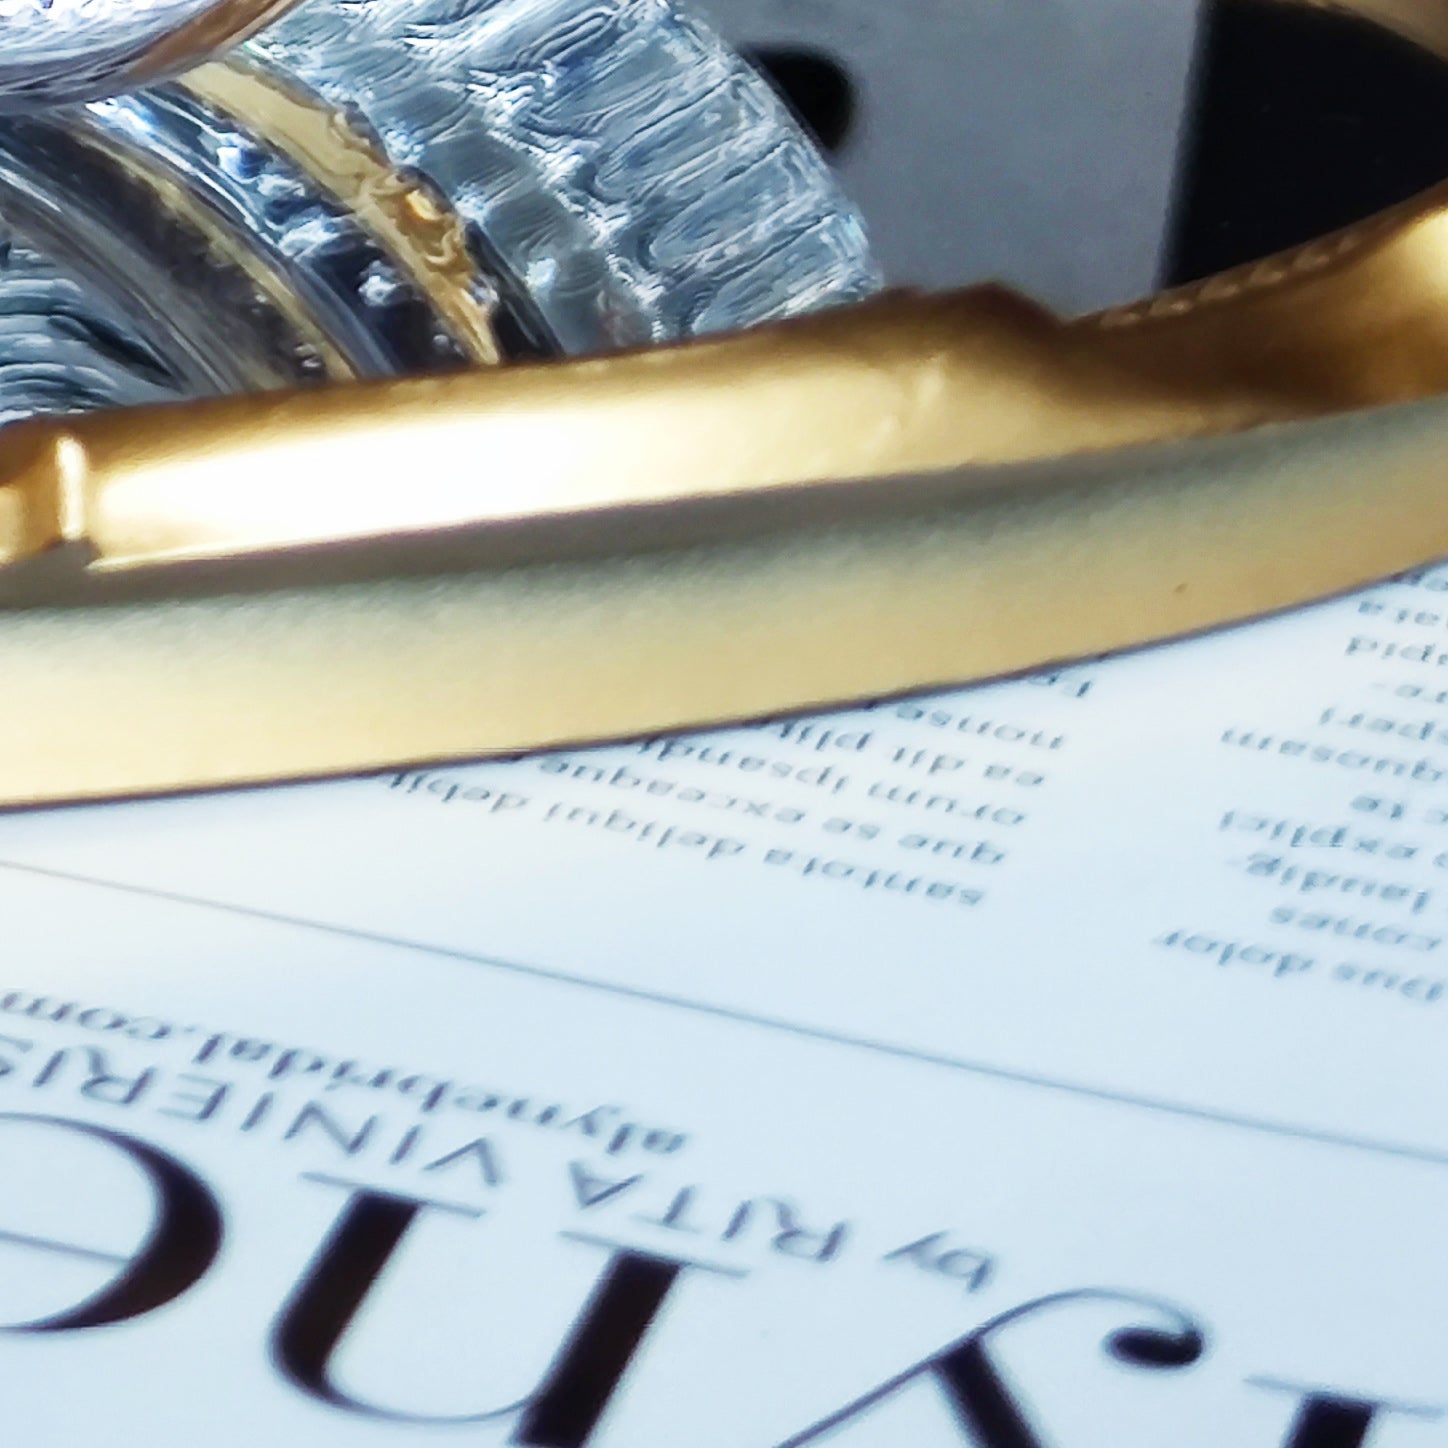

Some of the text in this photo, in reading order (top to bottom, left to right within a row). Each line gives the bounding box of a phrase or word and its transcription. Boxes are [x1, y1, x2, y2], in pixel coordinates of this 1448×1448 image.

[897, 832, 1005, 866] que
[569, 1162, 849, 1262] RITA
[883, 1230, 996, 1294] by
